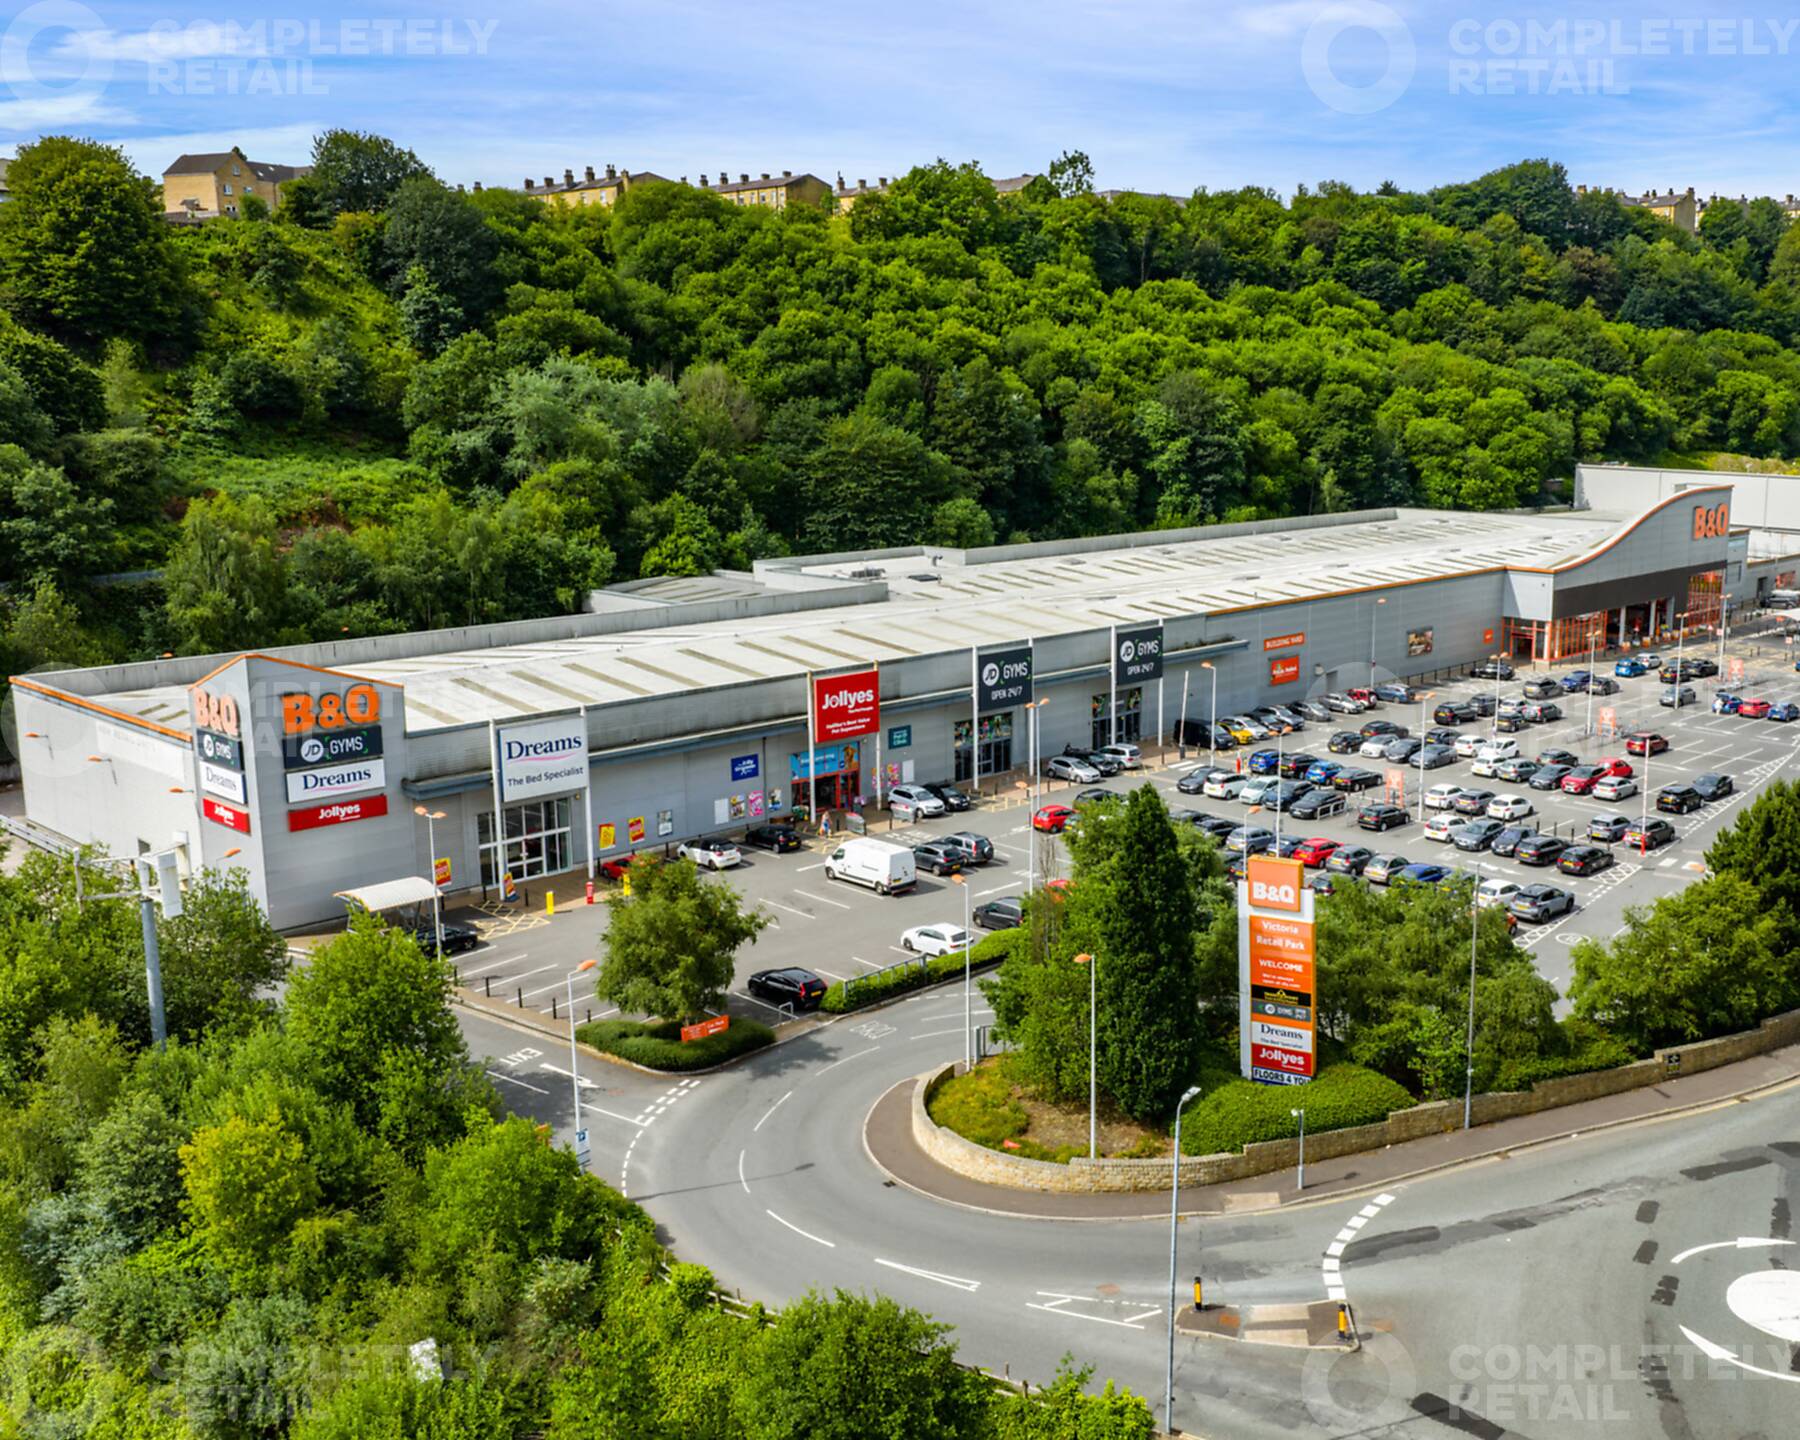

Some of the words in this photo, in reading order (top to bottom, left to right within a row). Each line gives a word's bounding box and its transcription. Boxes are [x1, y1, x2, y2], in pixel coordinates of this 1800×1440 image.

[1695, 503, 1730, 540] B&Q
[1137, 640, 1159, 656] GYMS
[1003, 661, 1028, 680] GYMS
[1127, 665, 1140, 676] OPEN
[822, 689, 874, 710] Jollyes
[991, 688, 1007, 700] OPEN
[1008, 685, 1023, 698] 24/7
[193, 686, 239, 737] B&Q
[281, 683, 381, 736] B&Q
[329, 735, 364, 755] GYMS
[506, 735, 582, 760] Dreams
[302, 767, 372, 790] Dreams
[508, 777, 524, 787] The
[525, 774, 542, 785] Bed
[543, 767, 584, 783] Specialist
[319, 803, 361, 819] Jollyes
[1252, 881, 1295, 904] B&Q
[1262, 920, 1299, 935] Victoria
[1256, 935, 1282, 947] Retail
[1284, 939, 1305, 950] Park
[1259, 959, 1304, 973] WELCOME
[1261, 1024, 1303, 1039] Dreams
[1259, 1048, 1305, 1066] Jollyes
[1254, 1069, 1285, 1082] FLOORS
